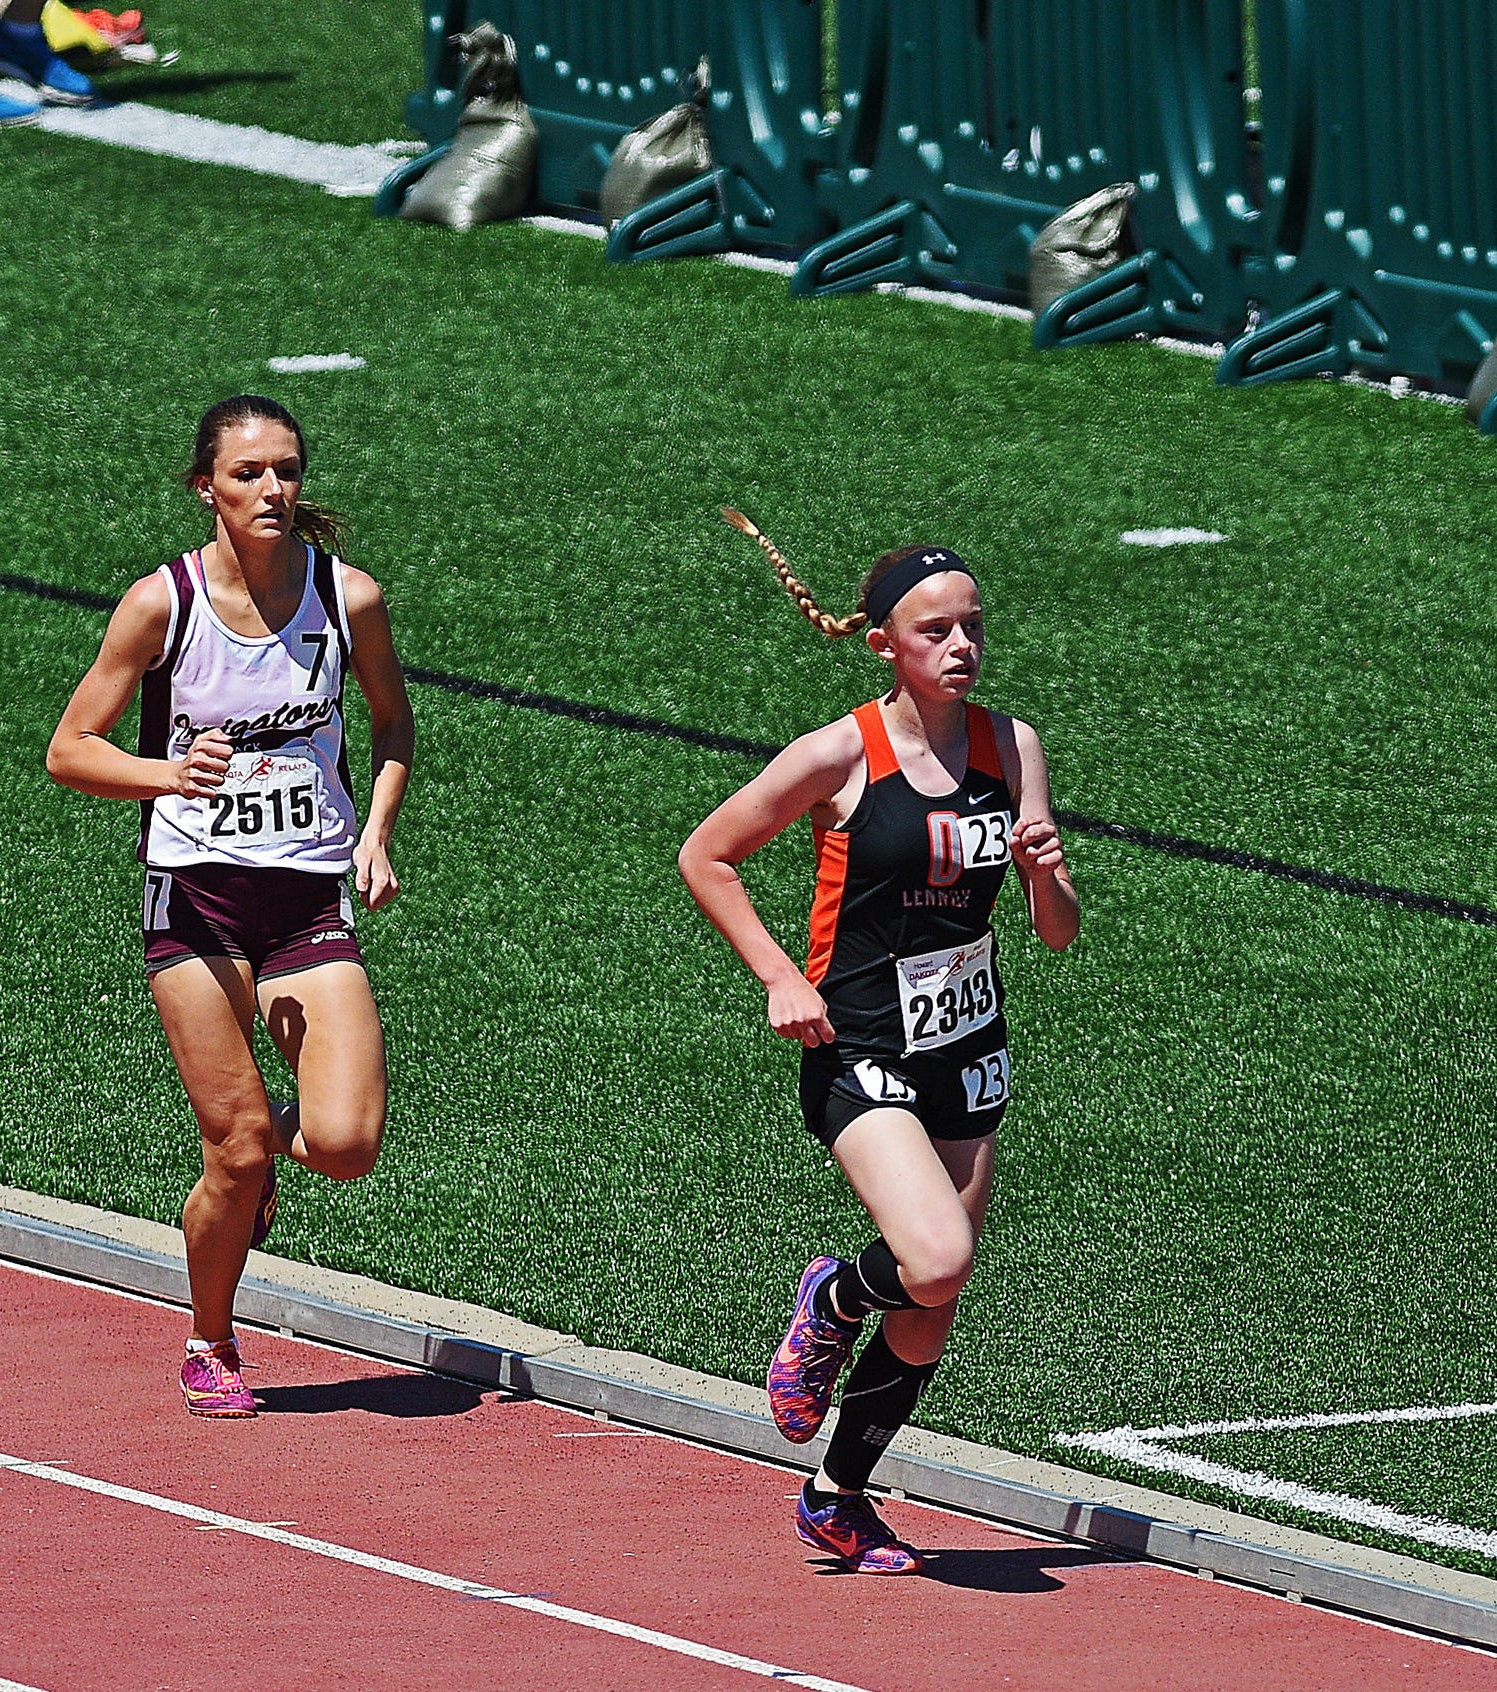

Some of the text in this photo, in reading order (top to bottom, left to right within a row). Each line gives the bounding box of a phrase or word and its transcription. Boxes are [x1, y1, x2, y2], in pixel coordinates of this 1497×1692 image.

[301, 633, 329, 692] 7
[277, 762, 308, 773] RELAYS
[209, 783, 314, 837] 2515
[926, 809, 964, 887] D
[968, 815, 1008, 865] 23
[146, 875, 165, 931] 7
[909, 968, 940, 981] DAKOTA
[909, 968, 993, 1041] 2343
[968, 1054, 1006, 1108] 23
